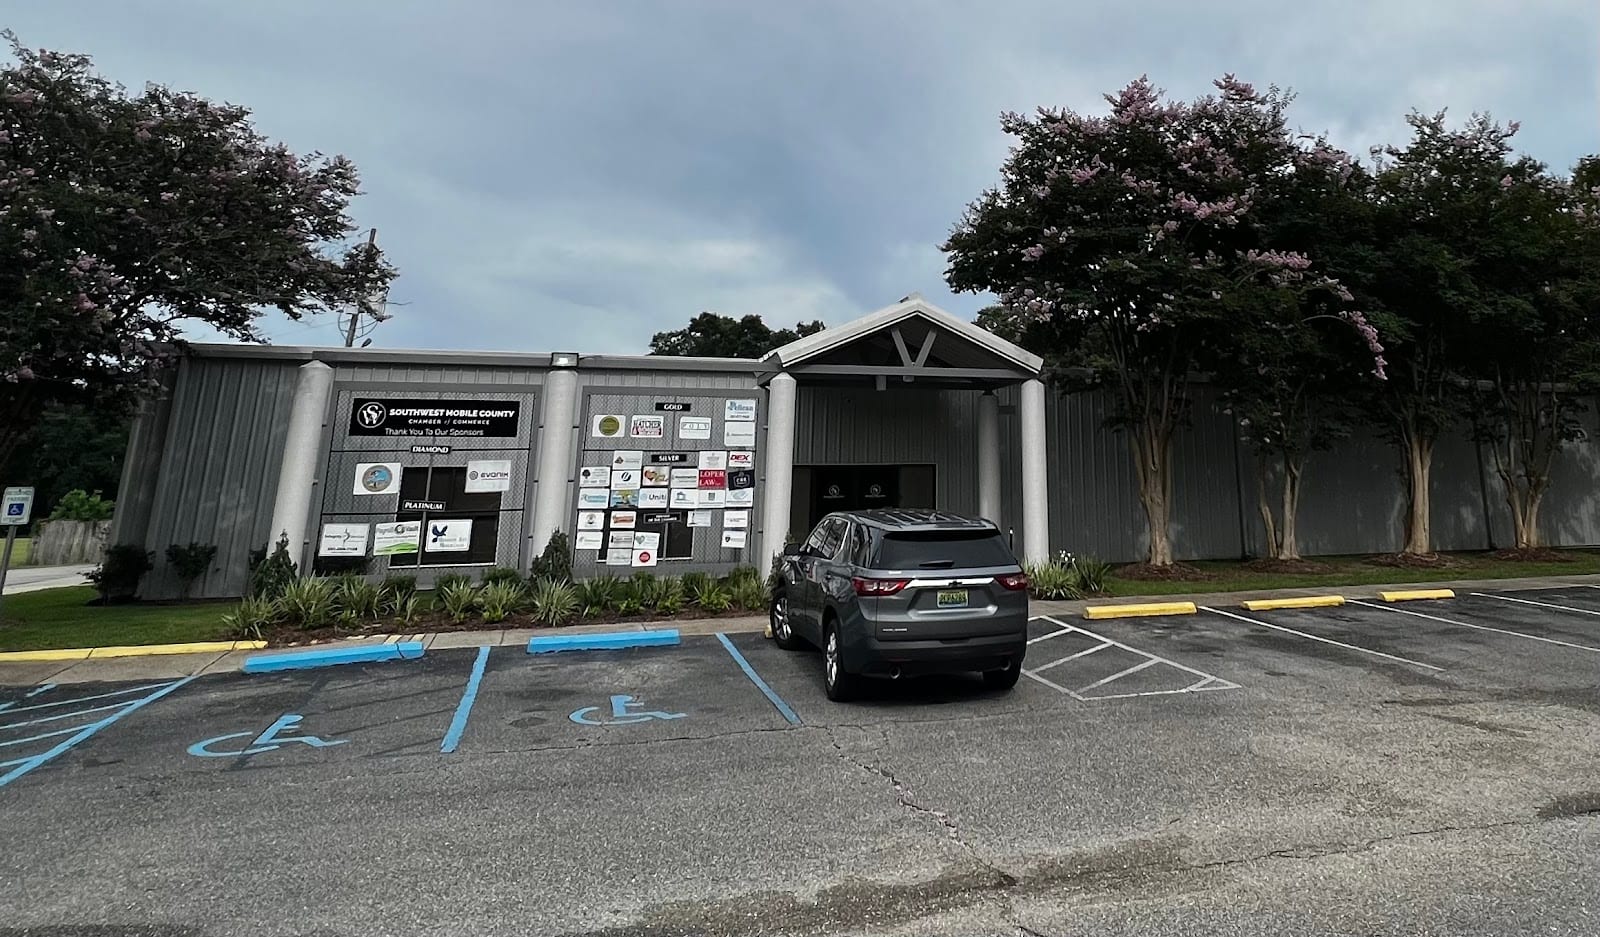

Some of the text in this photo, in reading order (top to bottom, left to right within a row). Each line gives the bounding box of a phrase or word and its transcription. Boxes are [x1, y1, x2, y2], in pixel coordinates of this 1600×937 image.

[663, 403, 683, 411] GOLD
[389, 408, 515, 418] SOUTHWEST MOBILE COUNTY
[385, 427, 484, 437] Thank You To Our Sponsors
[412, 446, 449, 454] DIAMOND
[658, 454, 680, 462] SILVER
[700, 470, 725, 478] LOPER
[404, 501, 443, 510] PLATINUM
